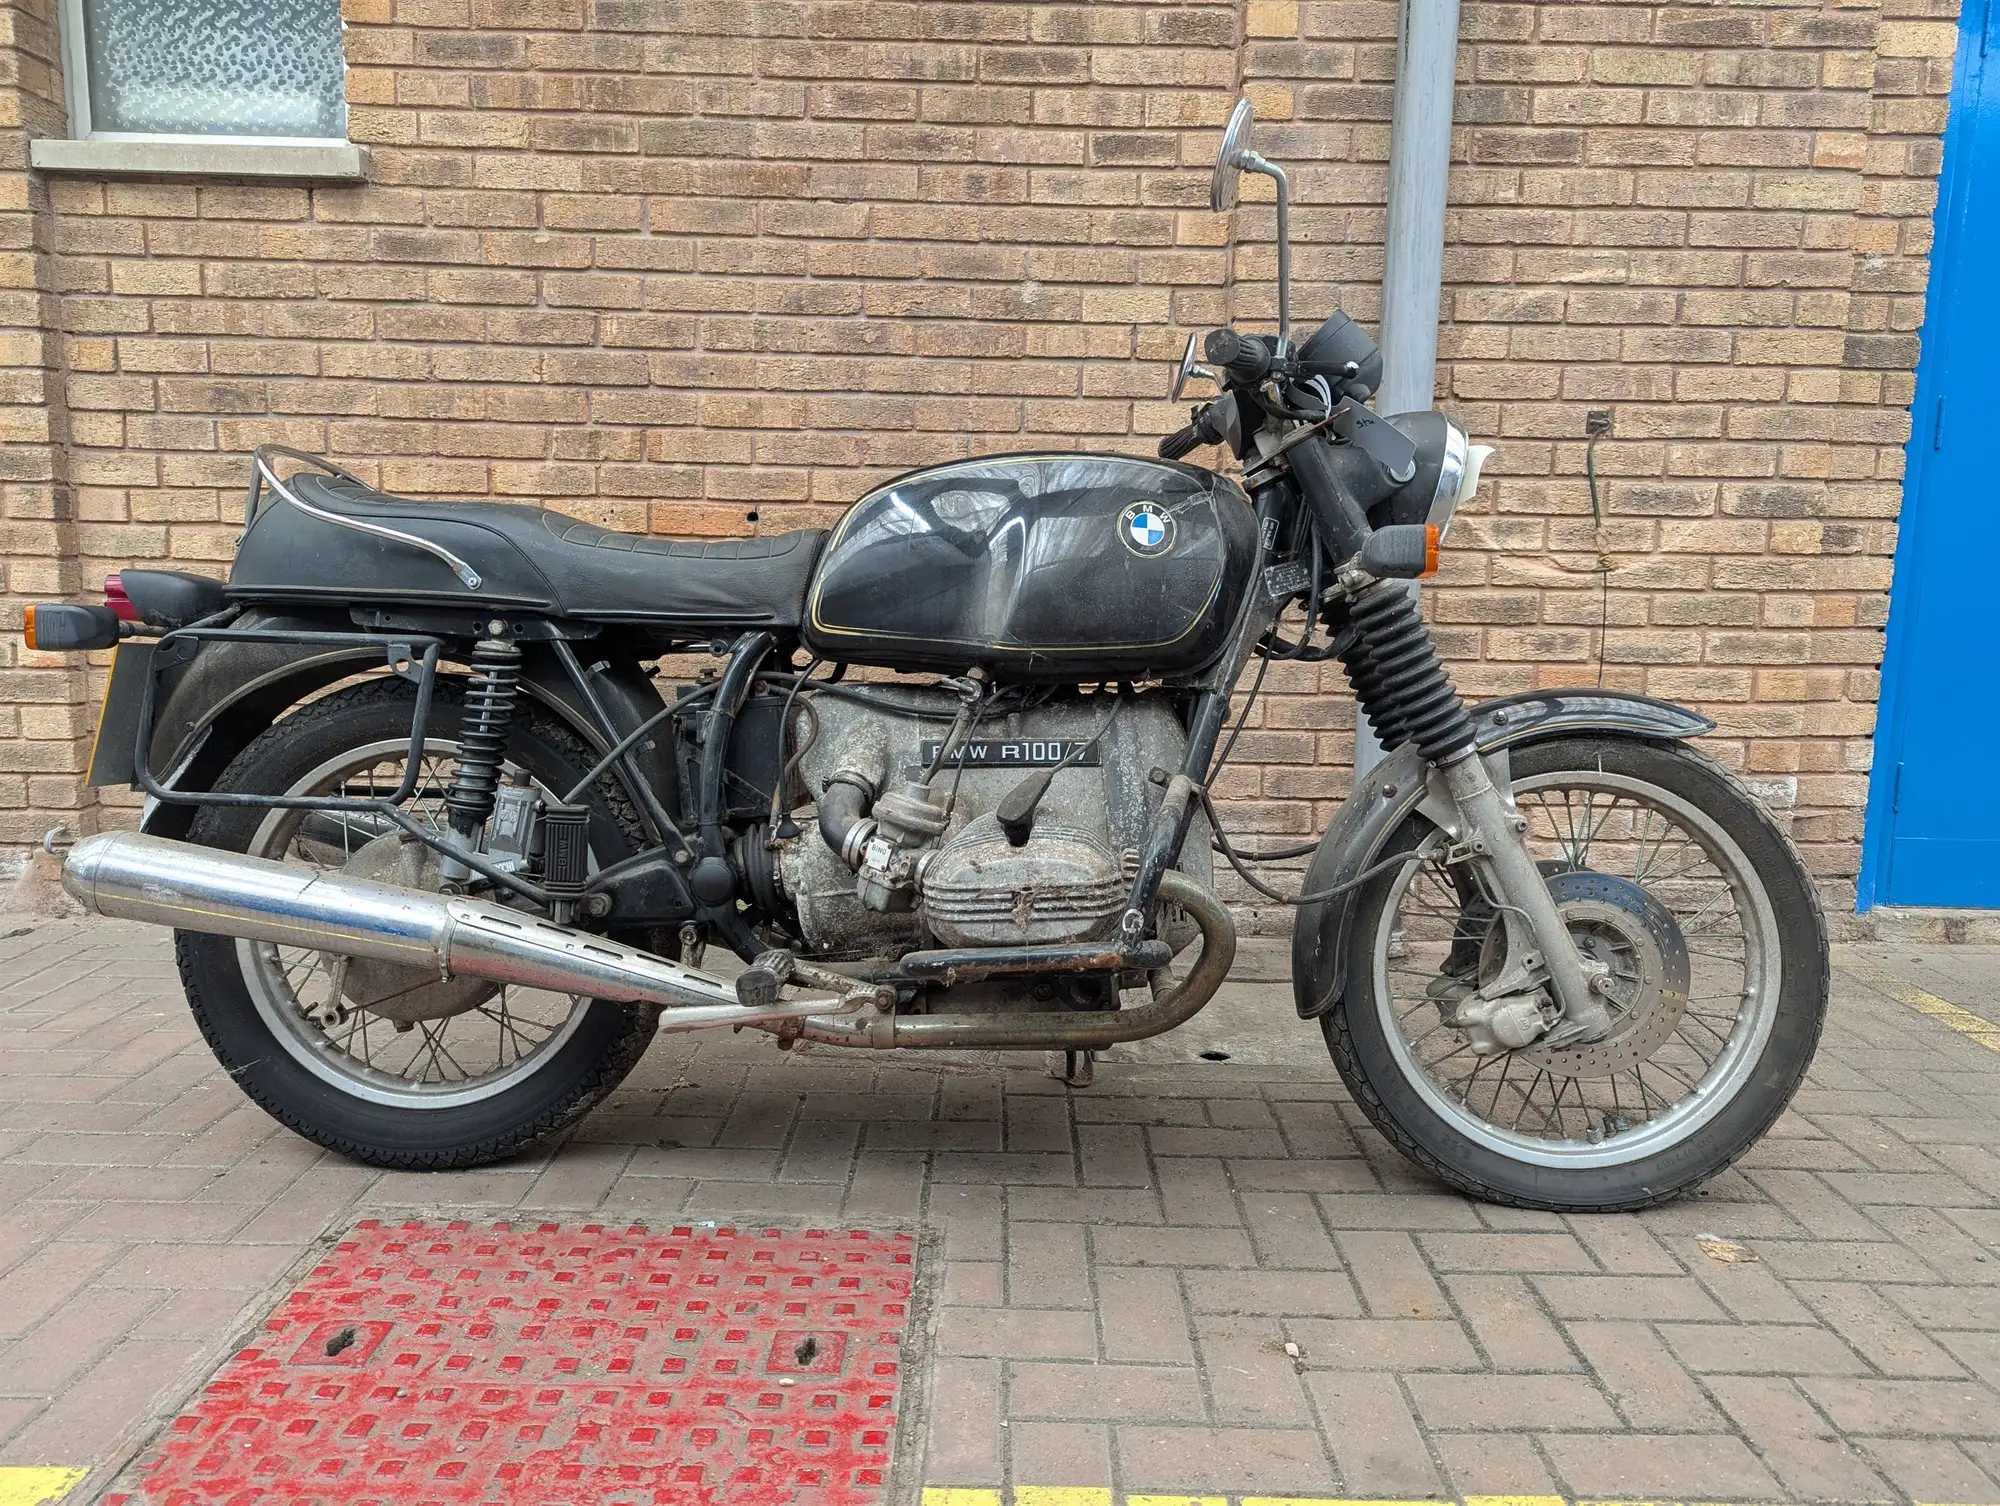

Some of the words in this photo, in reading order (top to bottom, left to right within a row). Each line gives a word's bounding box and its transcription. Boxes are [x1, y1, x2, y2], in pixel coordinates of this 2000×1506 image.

[1125, 505, 1171, 524] BMW
[1001, 742, 1087, 761] R100/7
[558, 840, 569, 867] BMW
